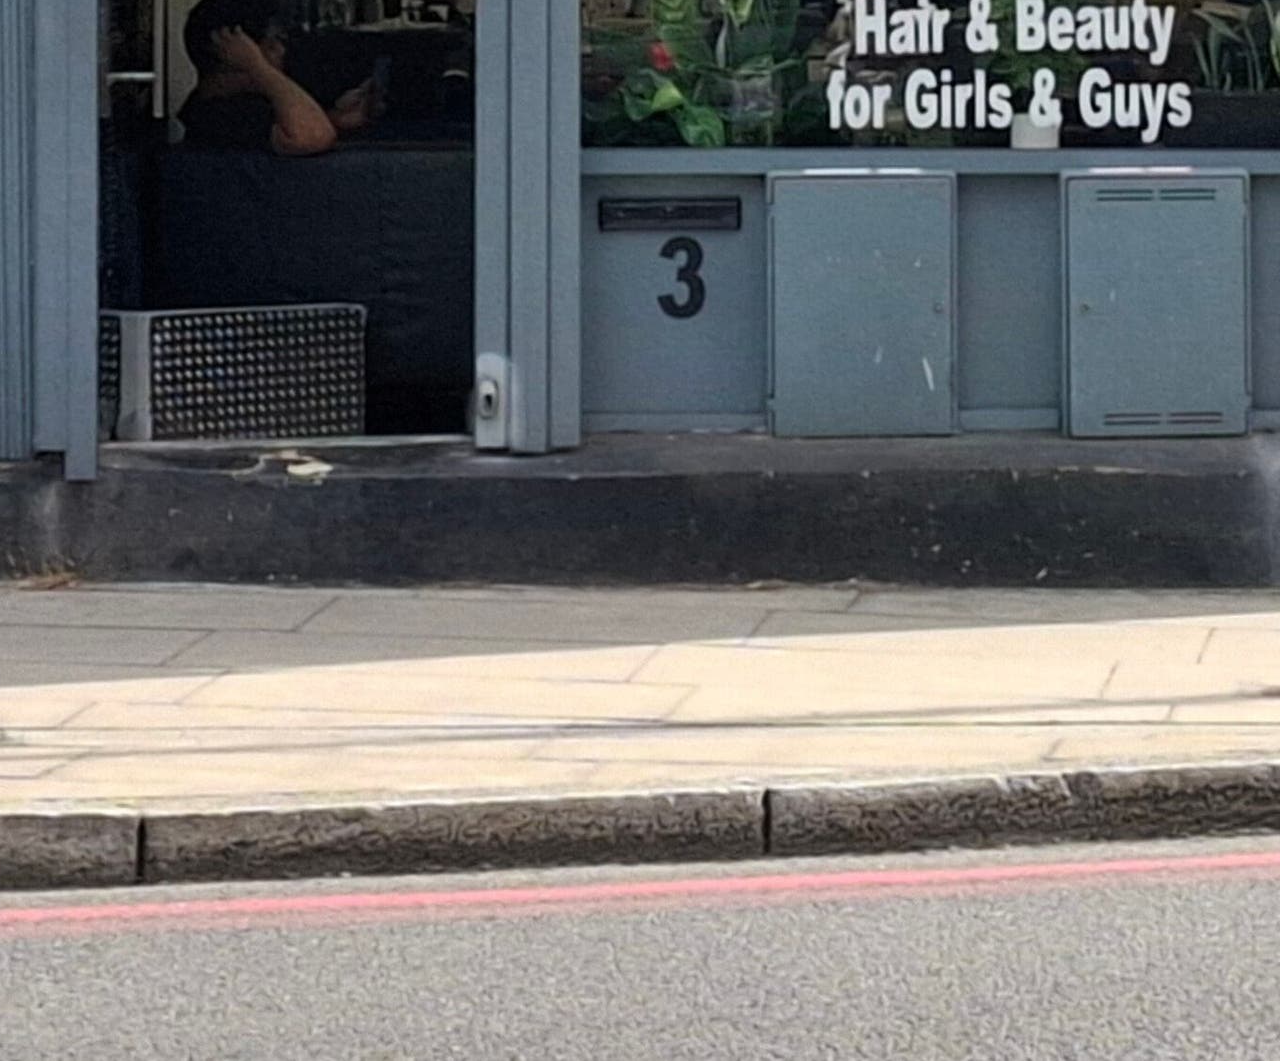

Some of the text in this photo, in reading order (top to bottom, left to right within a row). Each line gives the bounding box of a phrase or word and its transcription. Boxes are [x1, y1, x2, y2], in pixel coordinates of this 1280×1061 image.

[826, 68, 1192, 144] for Girls & Guys
[657, 236, 706, 319] 3
